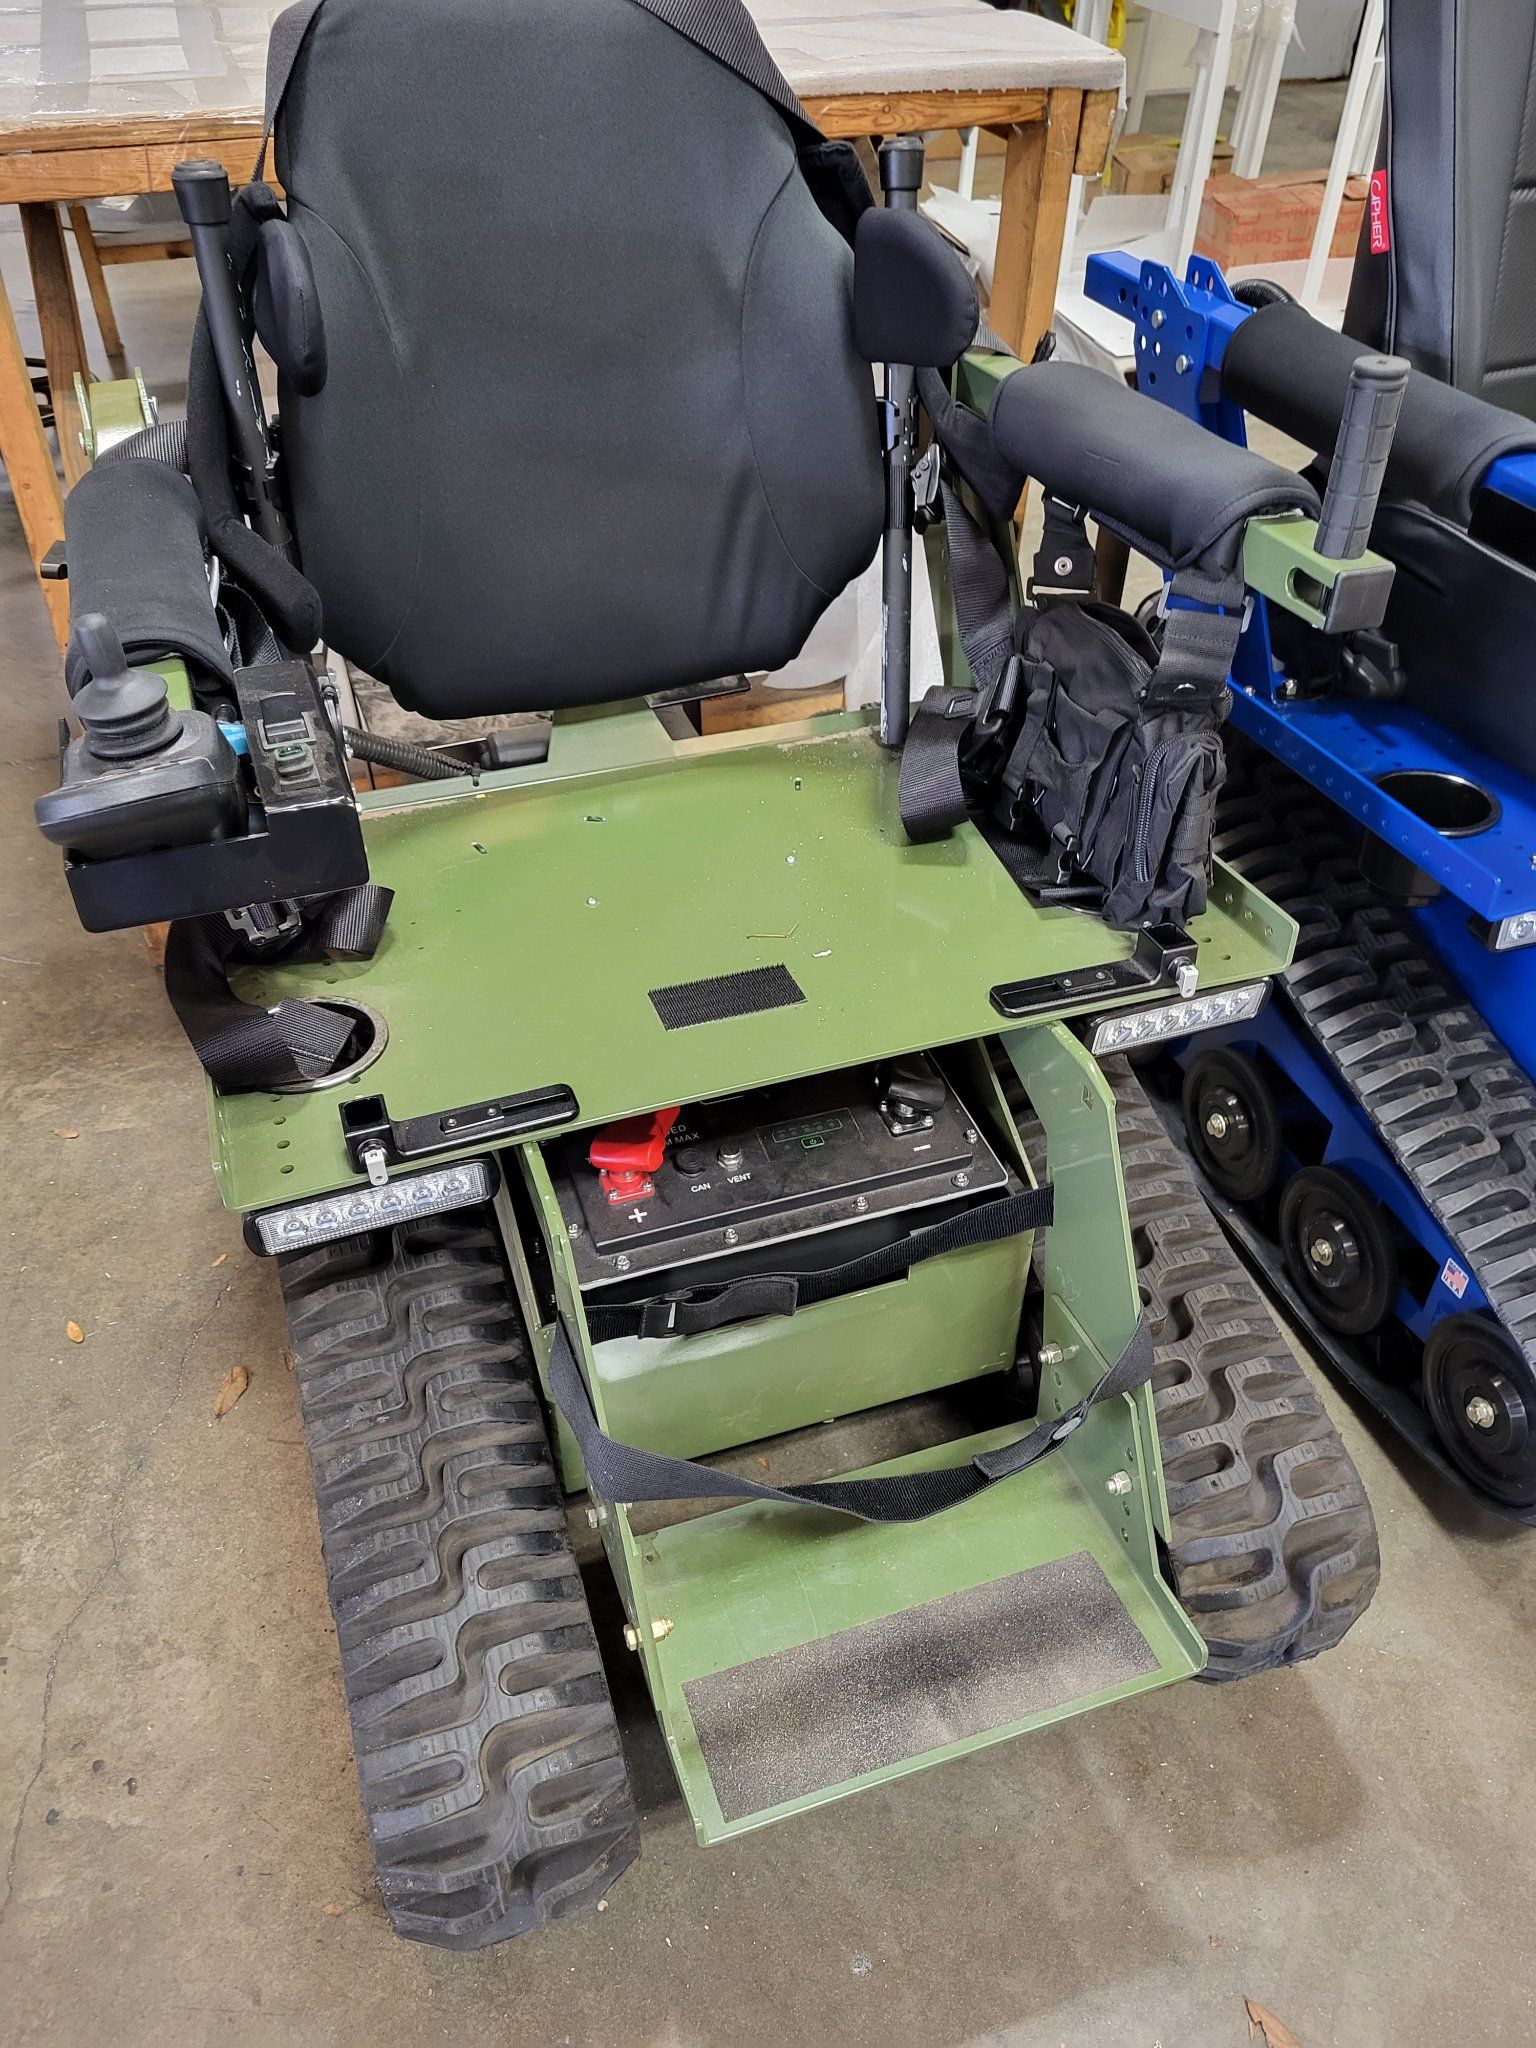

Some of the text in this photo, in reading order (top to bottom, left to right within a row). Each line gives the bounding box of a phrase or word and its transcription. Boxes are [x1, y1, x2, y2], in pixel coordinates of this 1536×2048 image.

[1370, 179, 1383, 248] CIPHER
[674, 1132, 700, 1144] MAX
[727, 1172, 752, 1185] VENT
[691, 1182, 711, 1193] CAN
